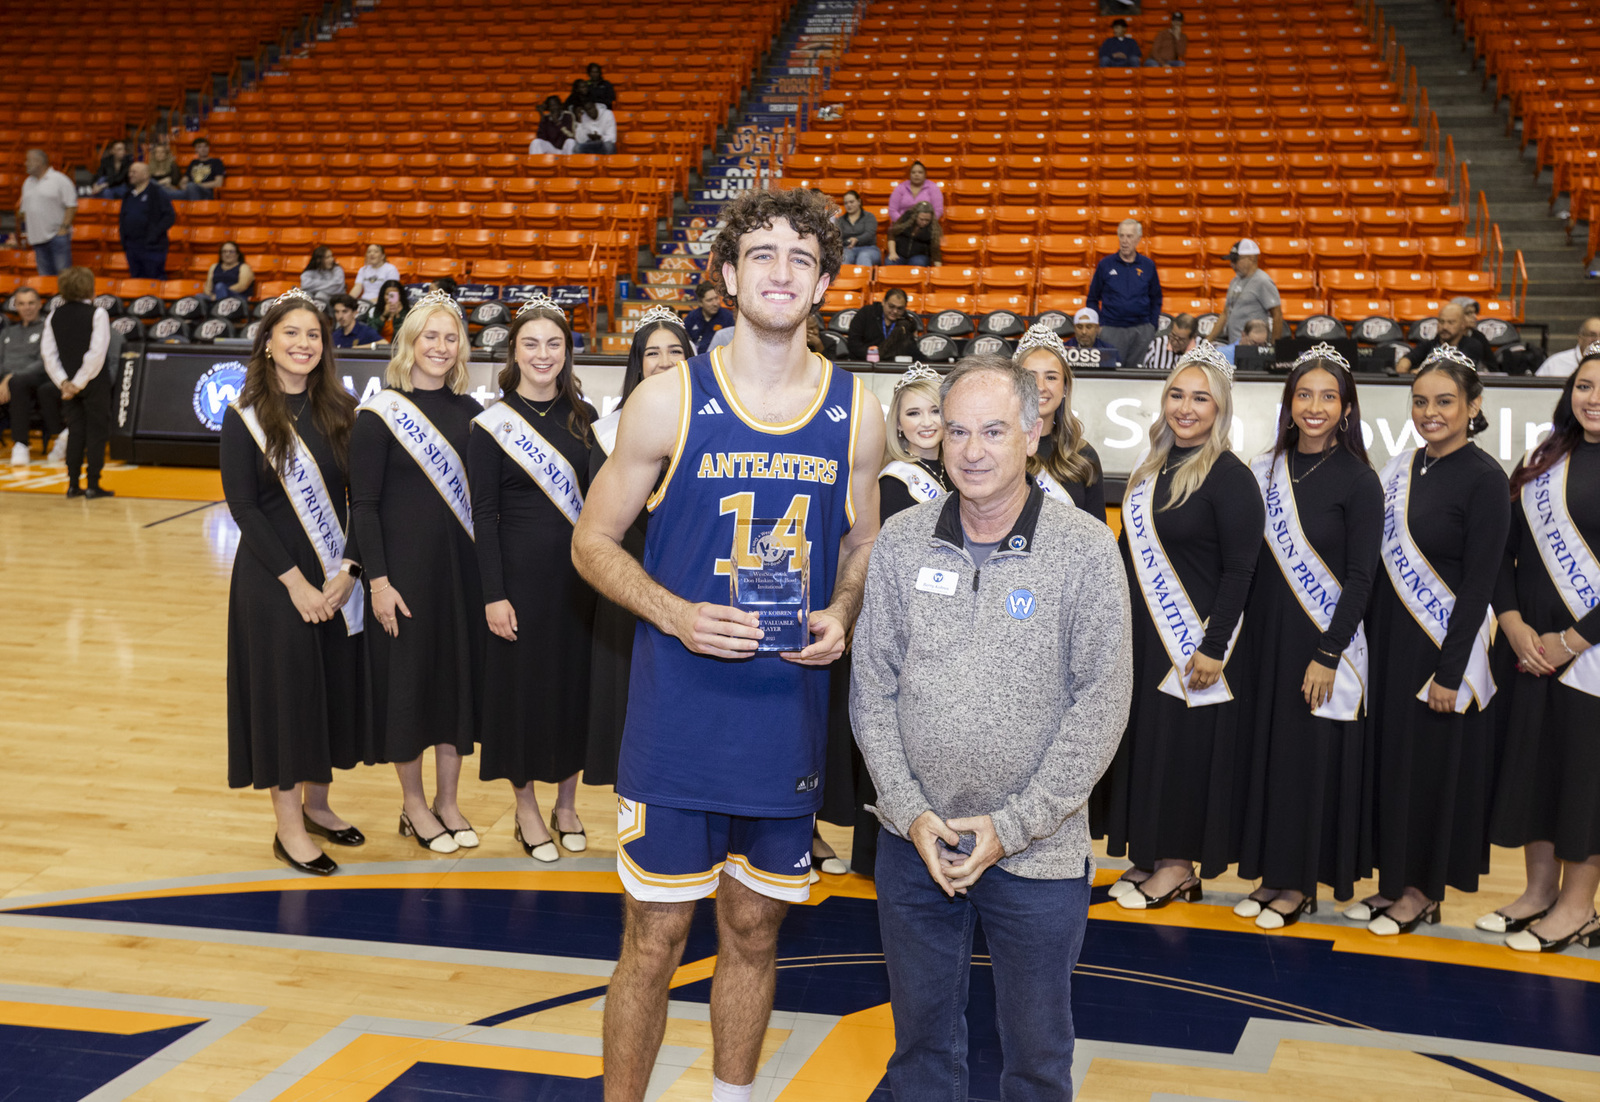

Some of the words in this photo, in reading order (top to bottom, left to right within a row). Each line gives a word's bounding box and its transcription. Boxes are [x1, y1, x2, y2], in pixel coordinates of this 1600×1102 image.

[396, 412, 427, 444] 2025
[423, 443, 453, 477] SUN
[514, 434, 547, 465] 2025
[543, 462, 574, 496] SUN
[697, 452, 839, 486] ANTEATERS
[300, 484, 340, 559] PRINCESS
[714, 491, 813, 577] 14
[1535, 489, 1556, 526] SUN
[1273, 520, 1298, 559] SUN
[1130, 491, 1148, 540] LADY
[1141, 545, 1158, 570] IN
[1151, 571, 1197, 657] WAITING
